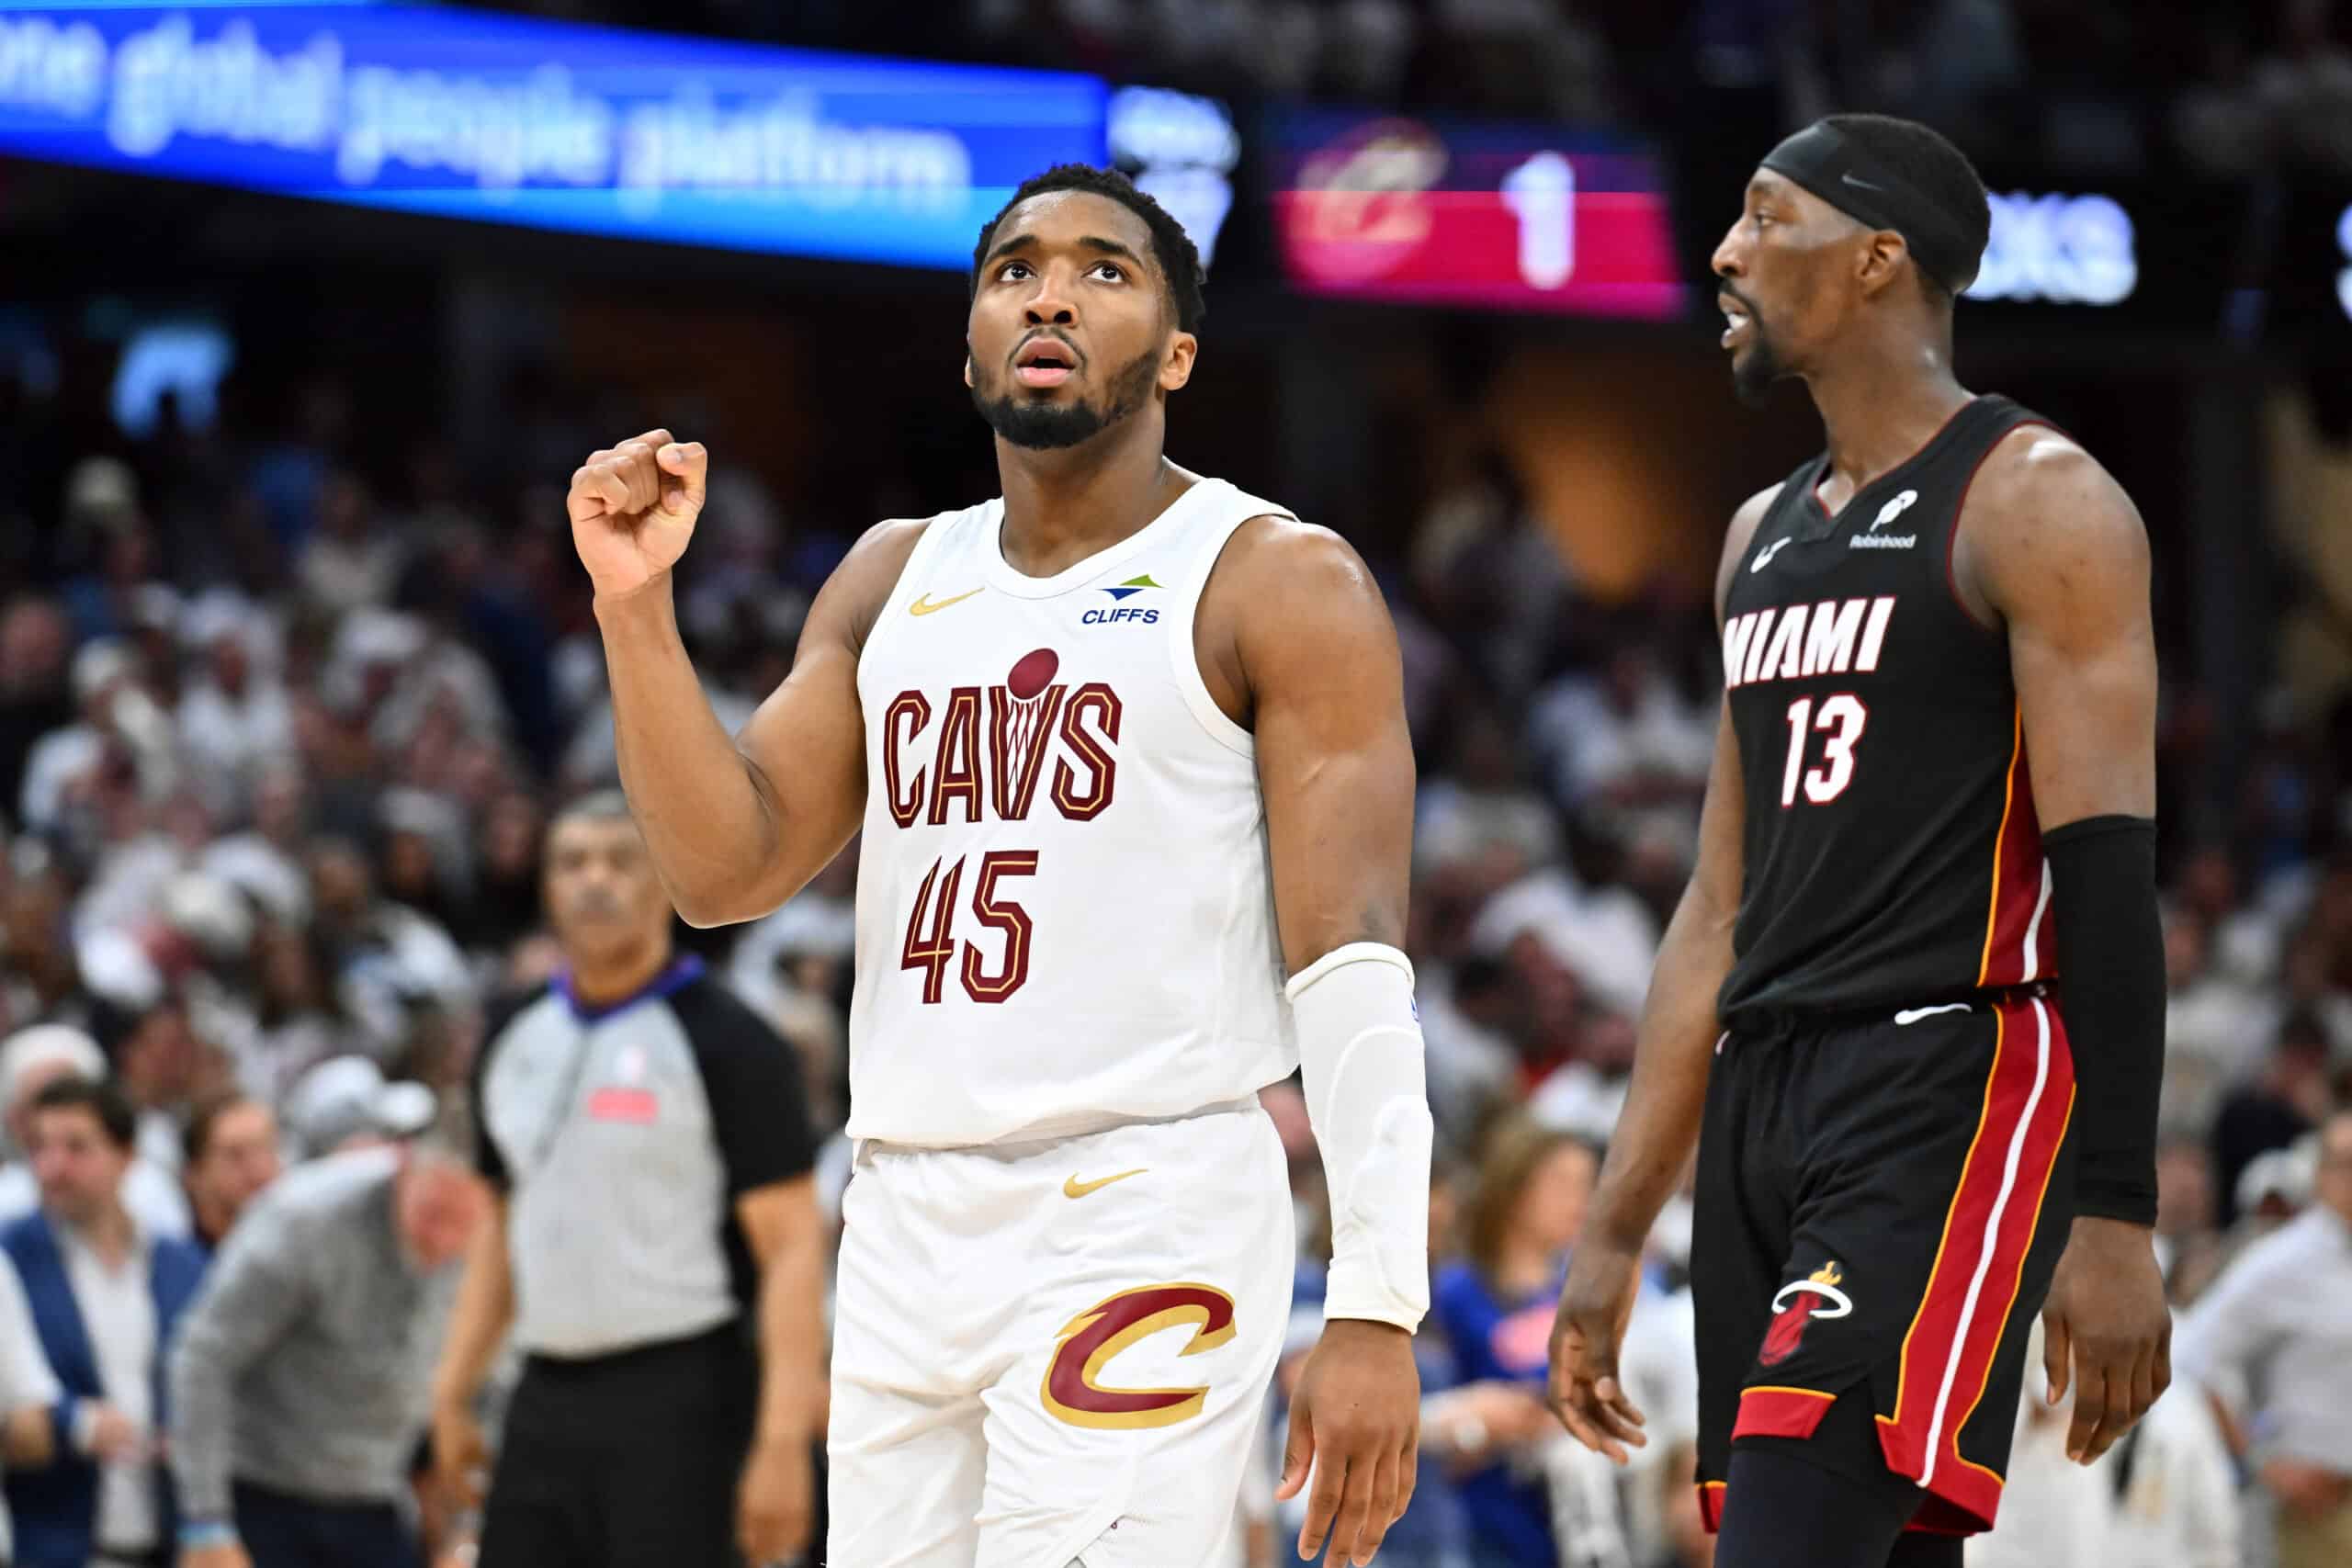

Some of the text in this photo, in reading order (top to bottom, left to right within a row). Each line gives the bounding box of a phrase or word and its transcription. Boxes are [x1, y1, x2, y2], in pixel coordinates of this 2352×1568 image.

[0, 17, 107, 117] ne
[108, 16, 344, 154] global
[338, 62, 610, 202] people
[617, 81, 968, 219] platform
[1499, 150, 1576, 289] 1
[1849, 534, 1917, 549] Robinhood
[1081, 608, 1159, 625] CLIFFS
[1722, 595, 1897, 691] MIAMI
[883, 682, 1123, 829] CAVS
[1781, 691, 1869, 809] 13
[901, 850, 1039, 1004] 45
